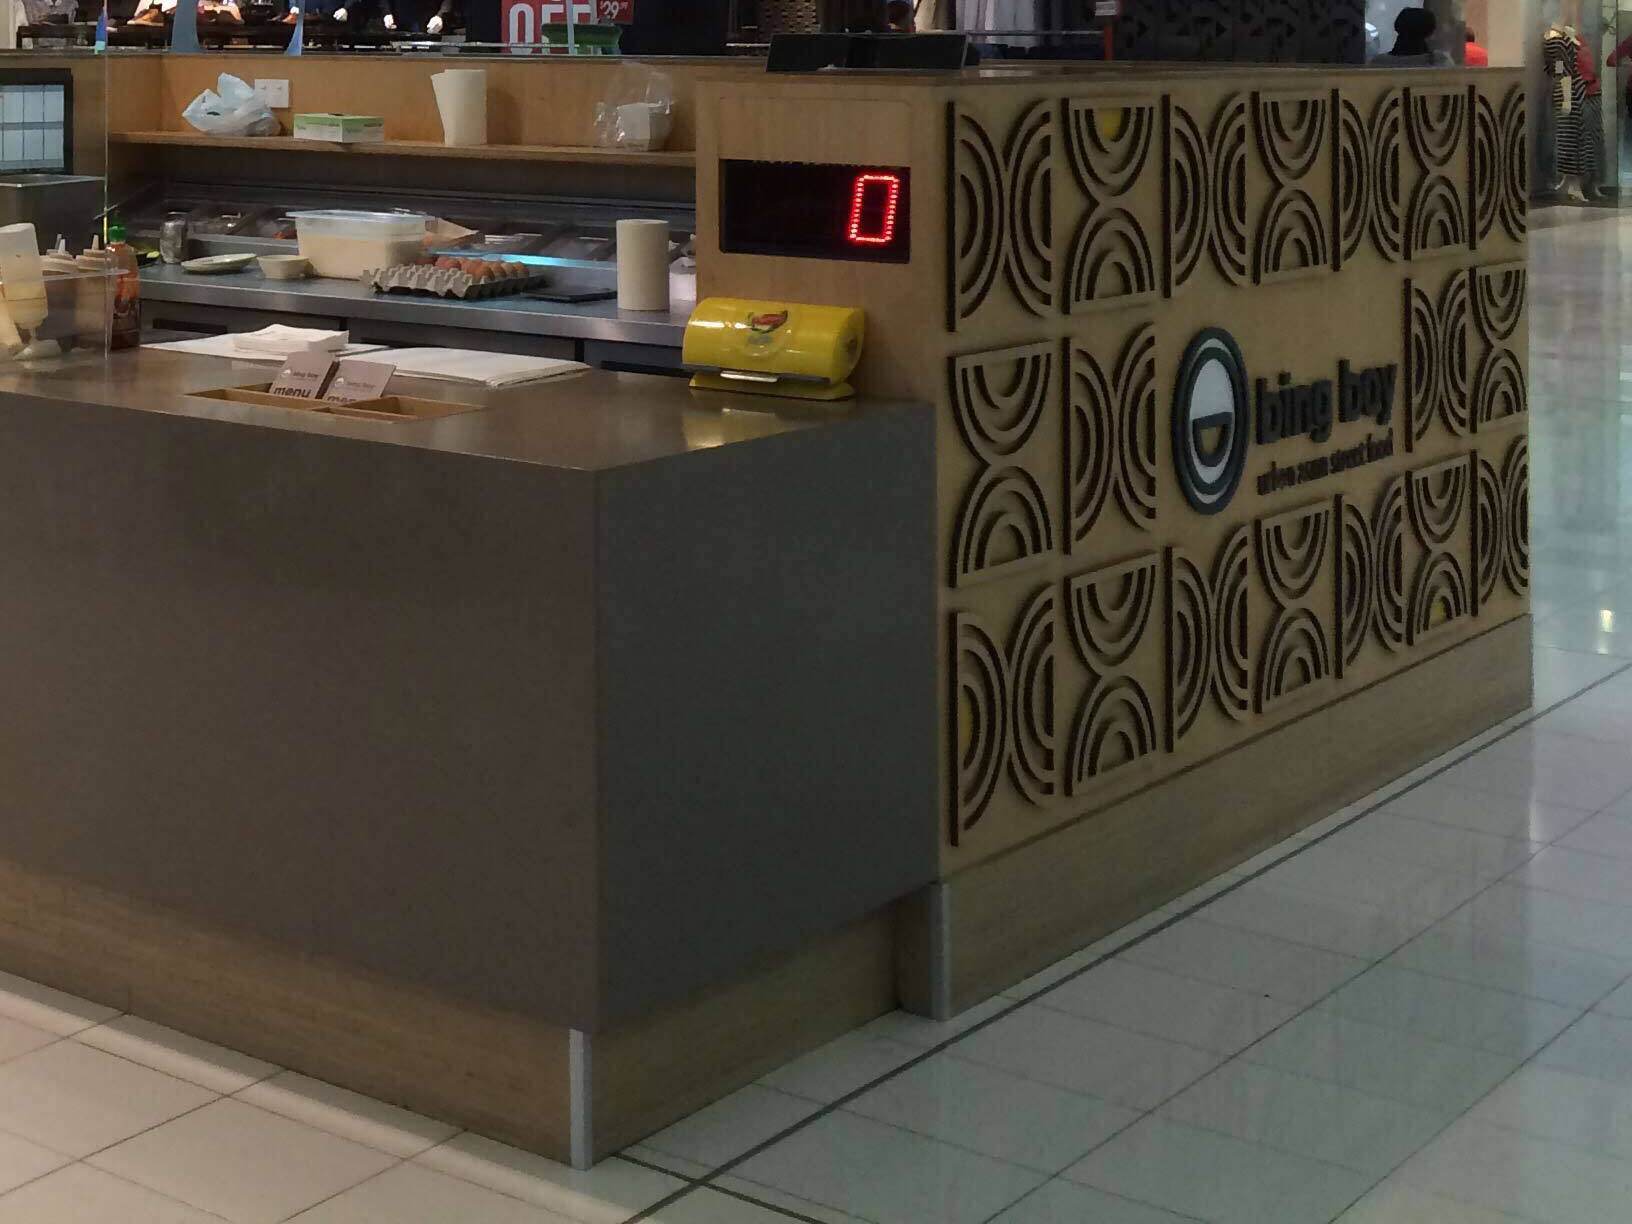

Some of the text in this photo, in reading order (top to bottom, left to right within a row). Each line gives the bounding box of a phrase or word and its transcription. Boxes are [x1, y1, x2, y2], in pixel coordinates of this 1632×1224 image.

[848, 174, 901, 244] 0
[1255, 358, 1398, 444] bing boy
